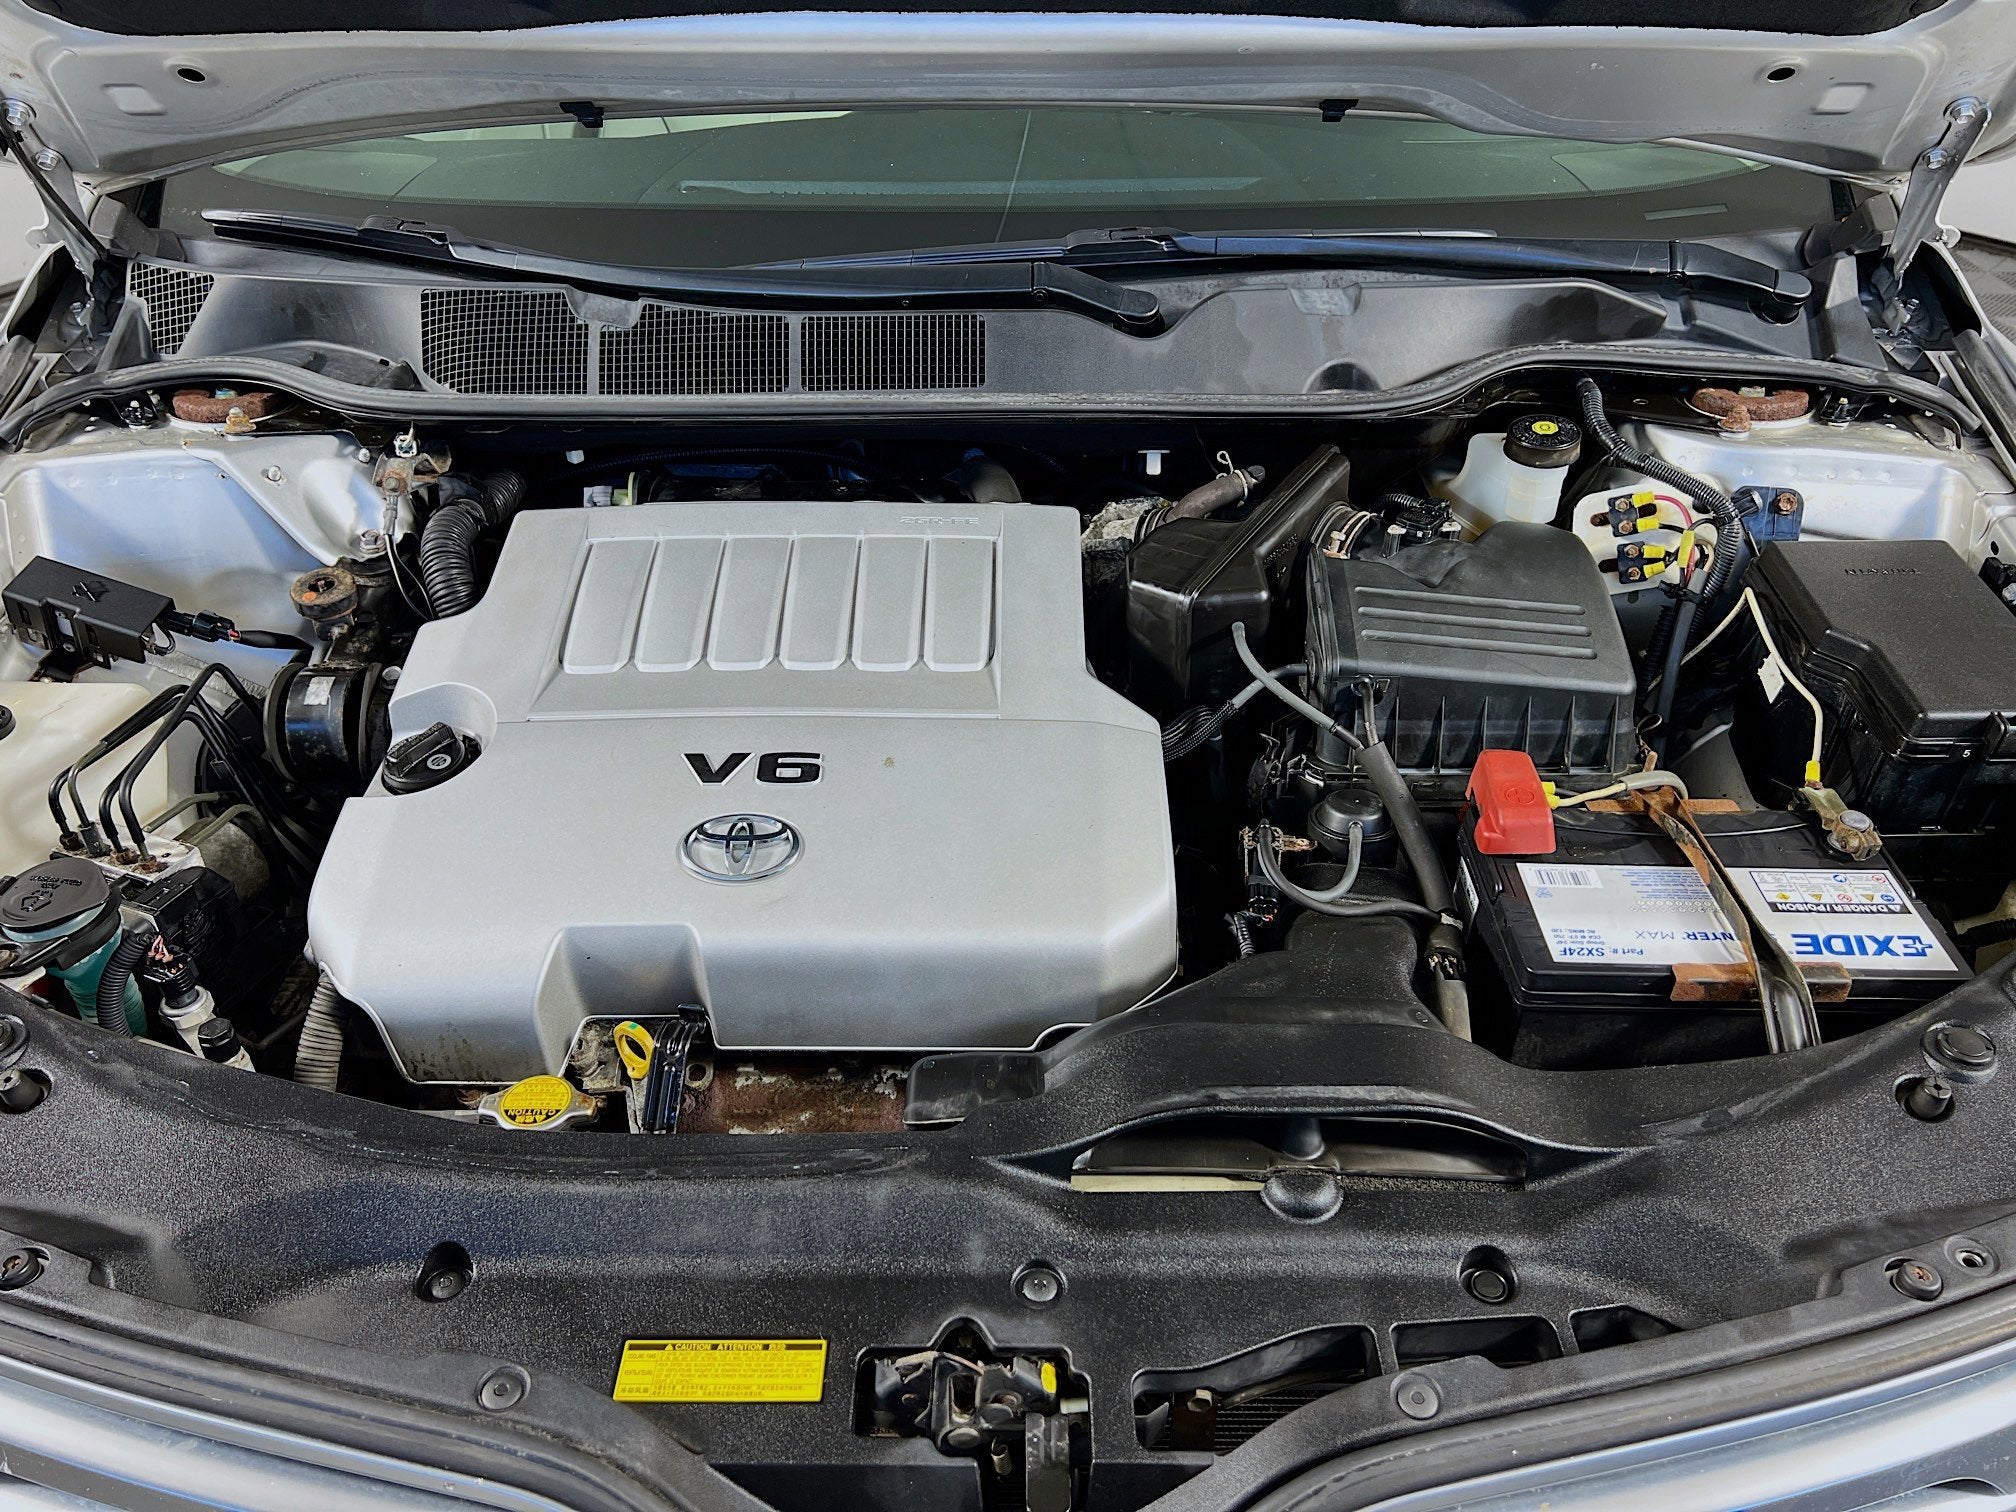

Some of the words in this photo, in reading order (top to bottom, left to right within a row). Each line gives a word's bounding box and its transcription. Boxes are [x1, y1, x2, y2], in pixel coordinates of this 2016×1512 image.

[680, 751, 824, 787] V6
[1833, 903, 1888, 913] DANGER
[1635, 930, 1675, 940] MAX
[1790, 933, 1934, 957] EXIDE
[1558, 947, 1605, 957] SX24F
[1621, 948, 1644, 956] Part
[675, 1343, 712, 1351] CAUTION
[716, 1343, 763, 1351] ATTENTION
